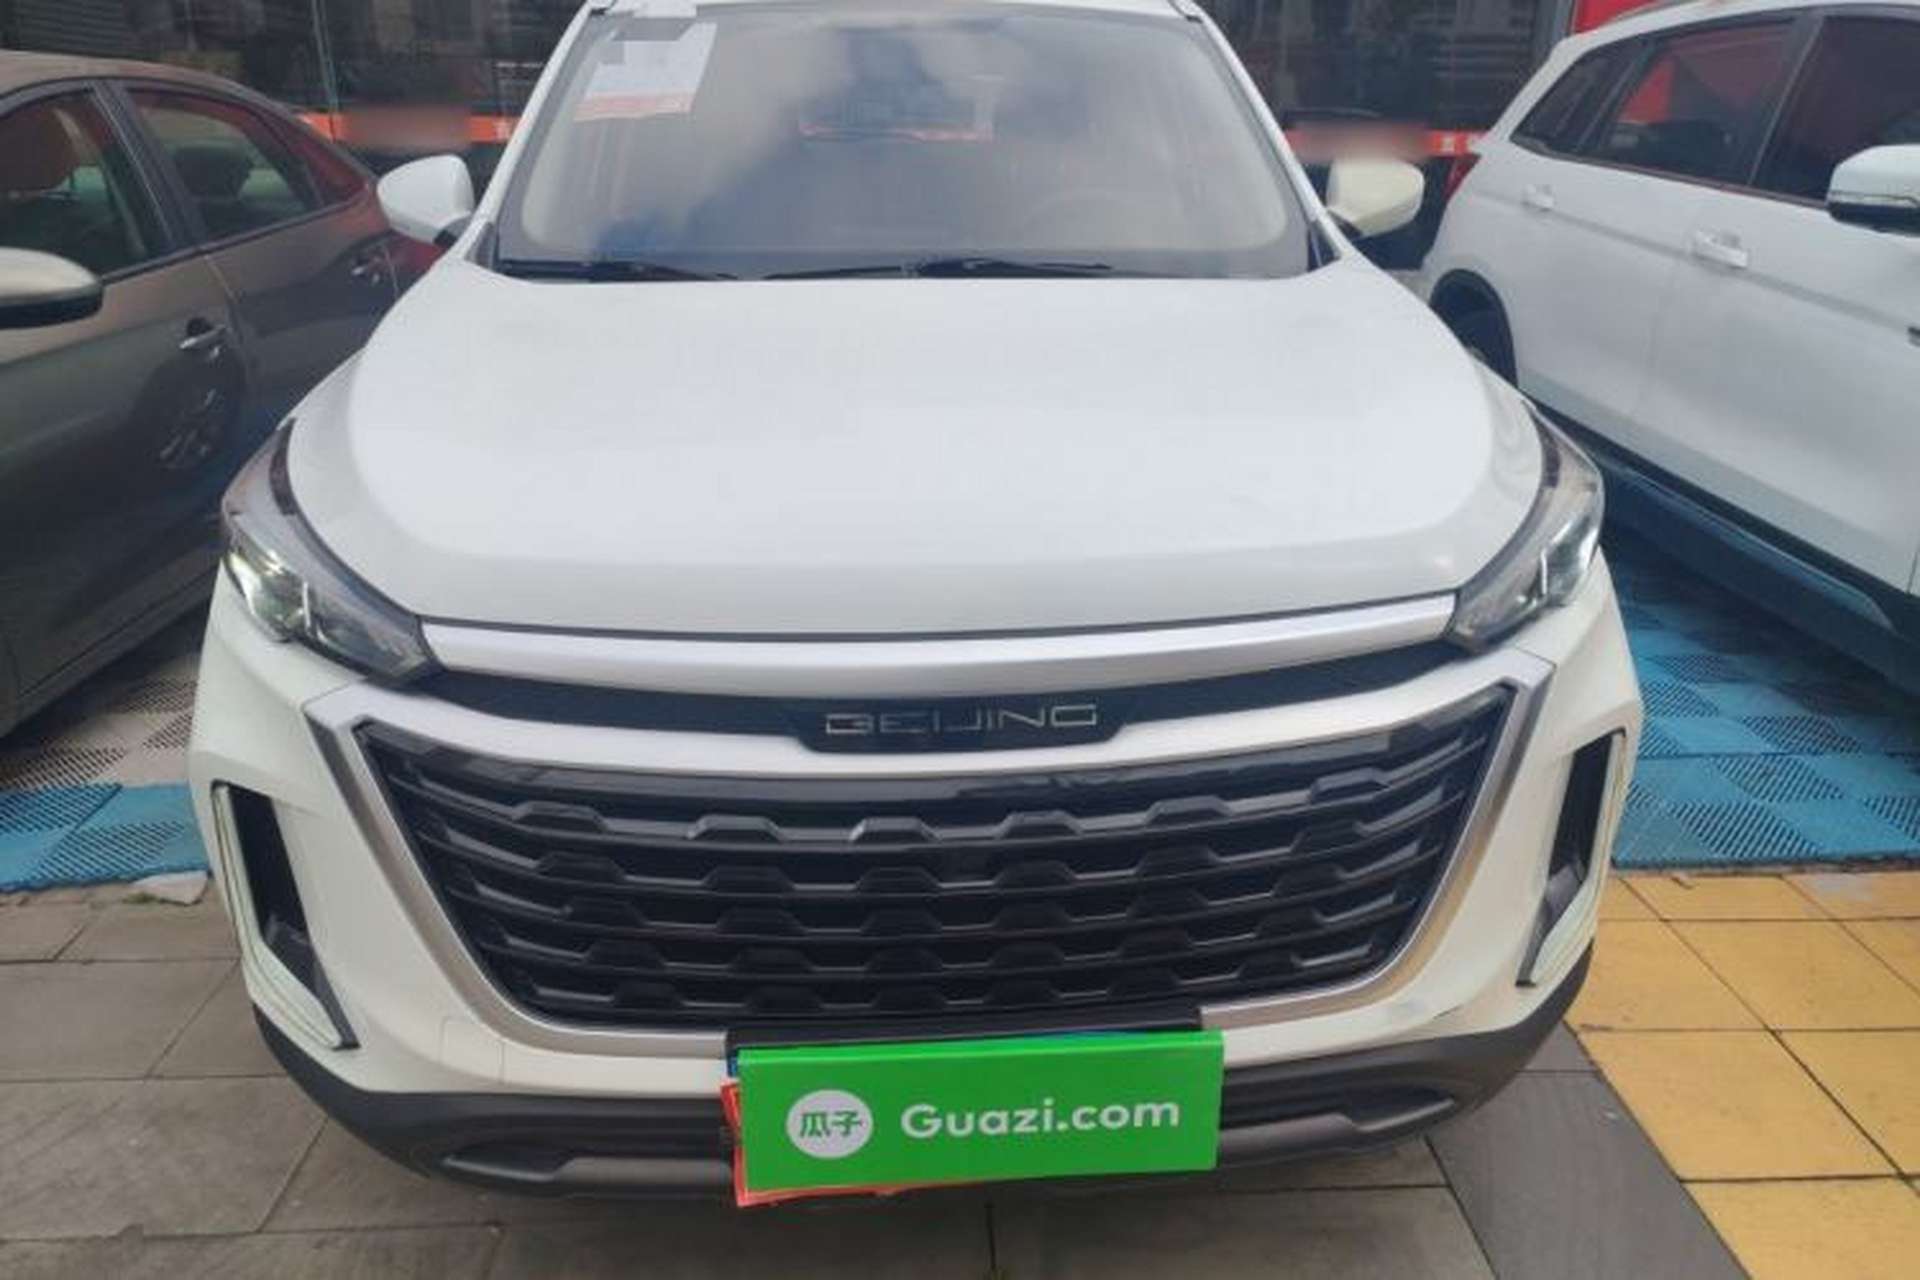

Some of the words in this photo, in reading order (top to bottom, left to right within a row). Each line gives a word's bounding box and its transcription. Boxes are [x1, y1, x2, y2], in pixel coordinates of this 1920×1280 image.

[825, 704, 1098, 734] BEIJING
[799, 1110, 863, 1139] 瓜子
[900, 1098, 1180, 1139] Guazi.com
